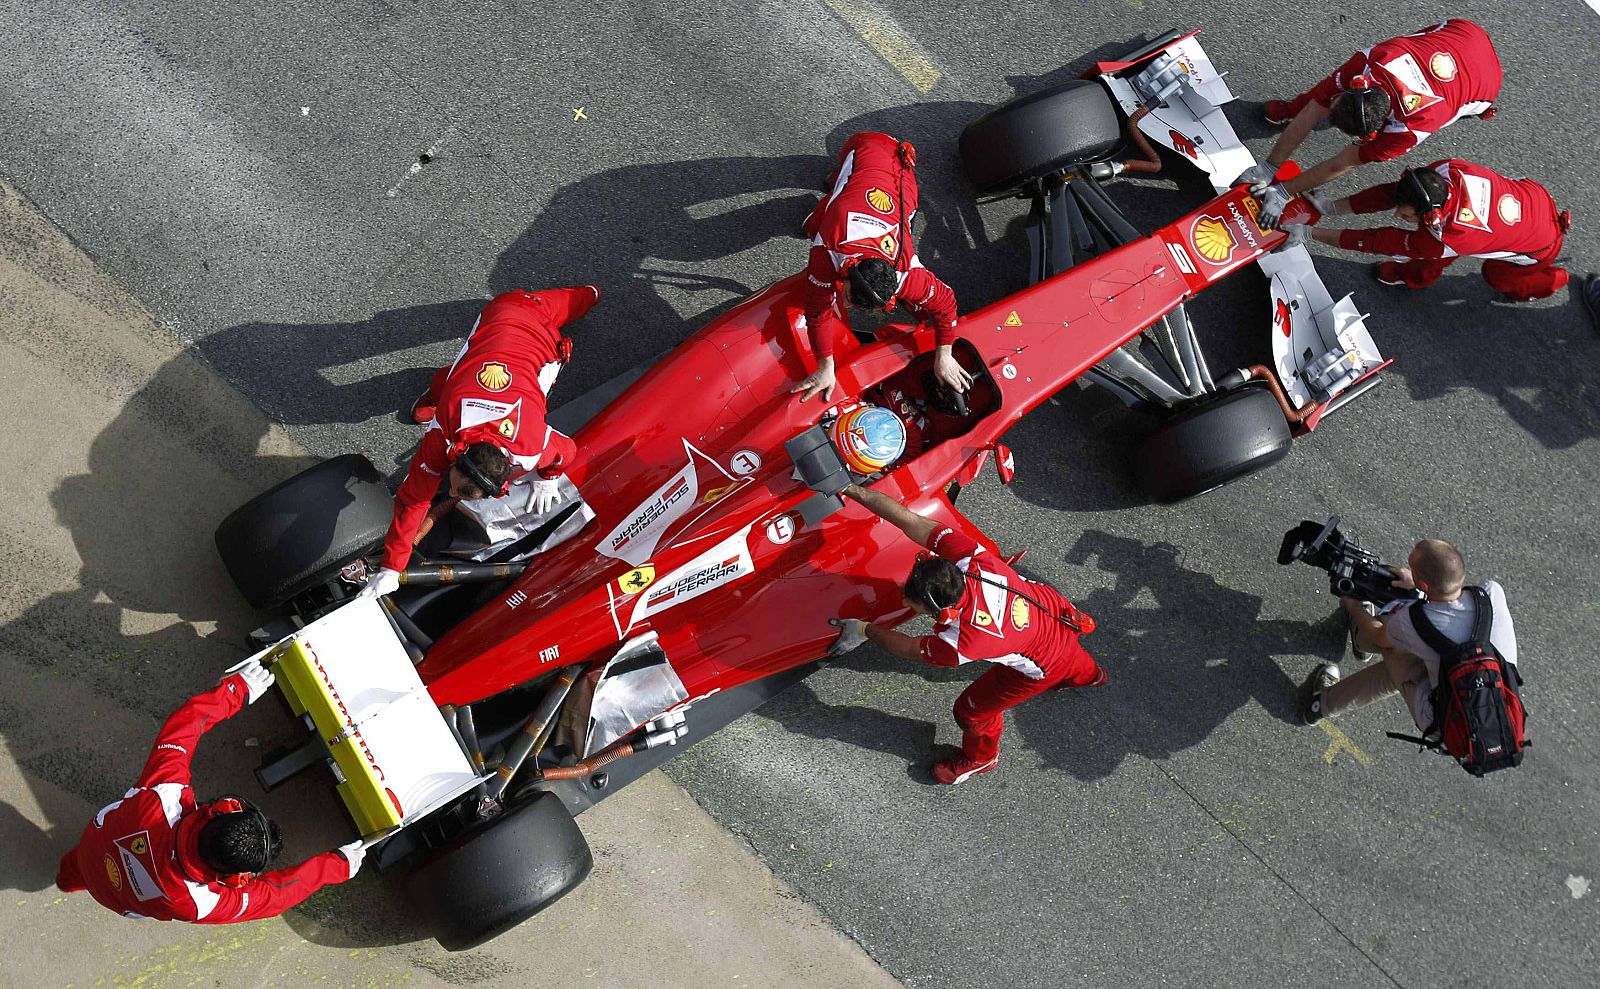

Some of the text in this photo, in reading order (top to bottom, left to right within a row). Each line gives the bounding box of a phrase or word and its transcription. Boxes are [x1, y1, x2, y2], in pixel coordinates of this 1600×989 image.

[736, 453, 756, 473] E
[611, 498, 662, 546] FERRARI
[630, 483, 689, 538] SCUDERIA
[773, 518, 789, 540] E
[648, 563, 721, 600] SCUDERIA
[677, 563, 738, 596] FERRARI
[505, 589, 528, 611] FIAT
[538, 644, 560, 664] FIAT
